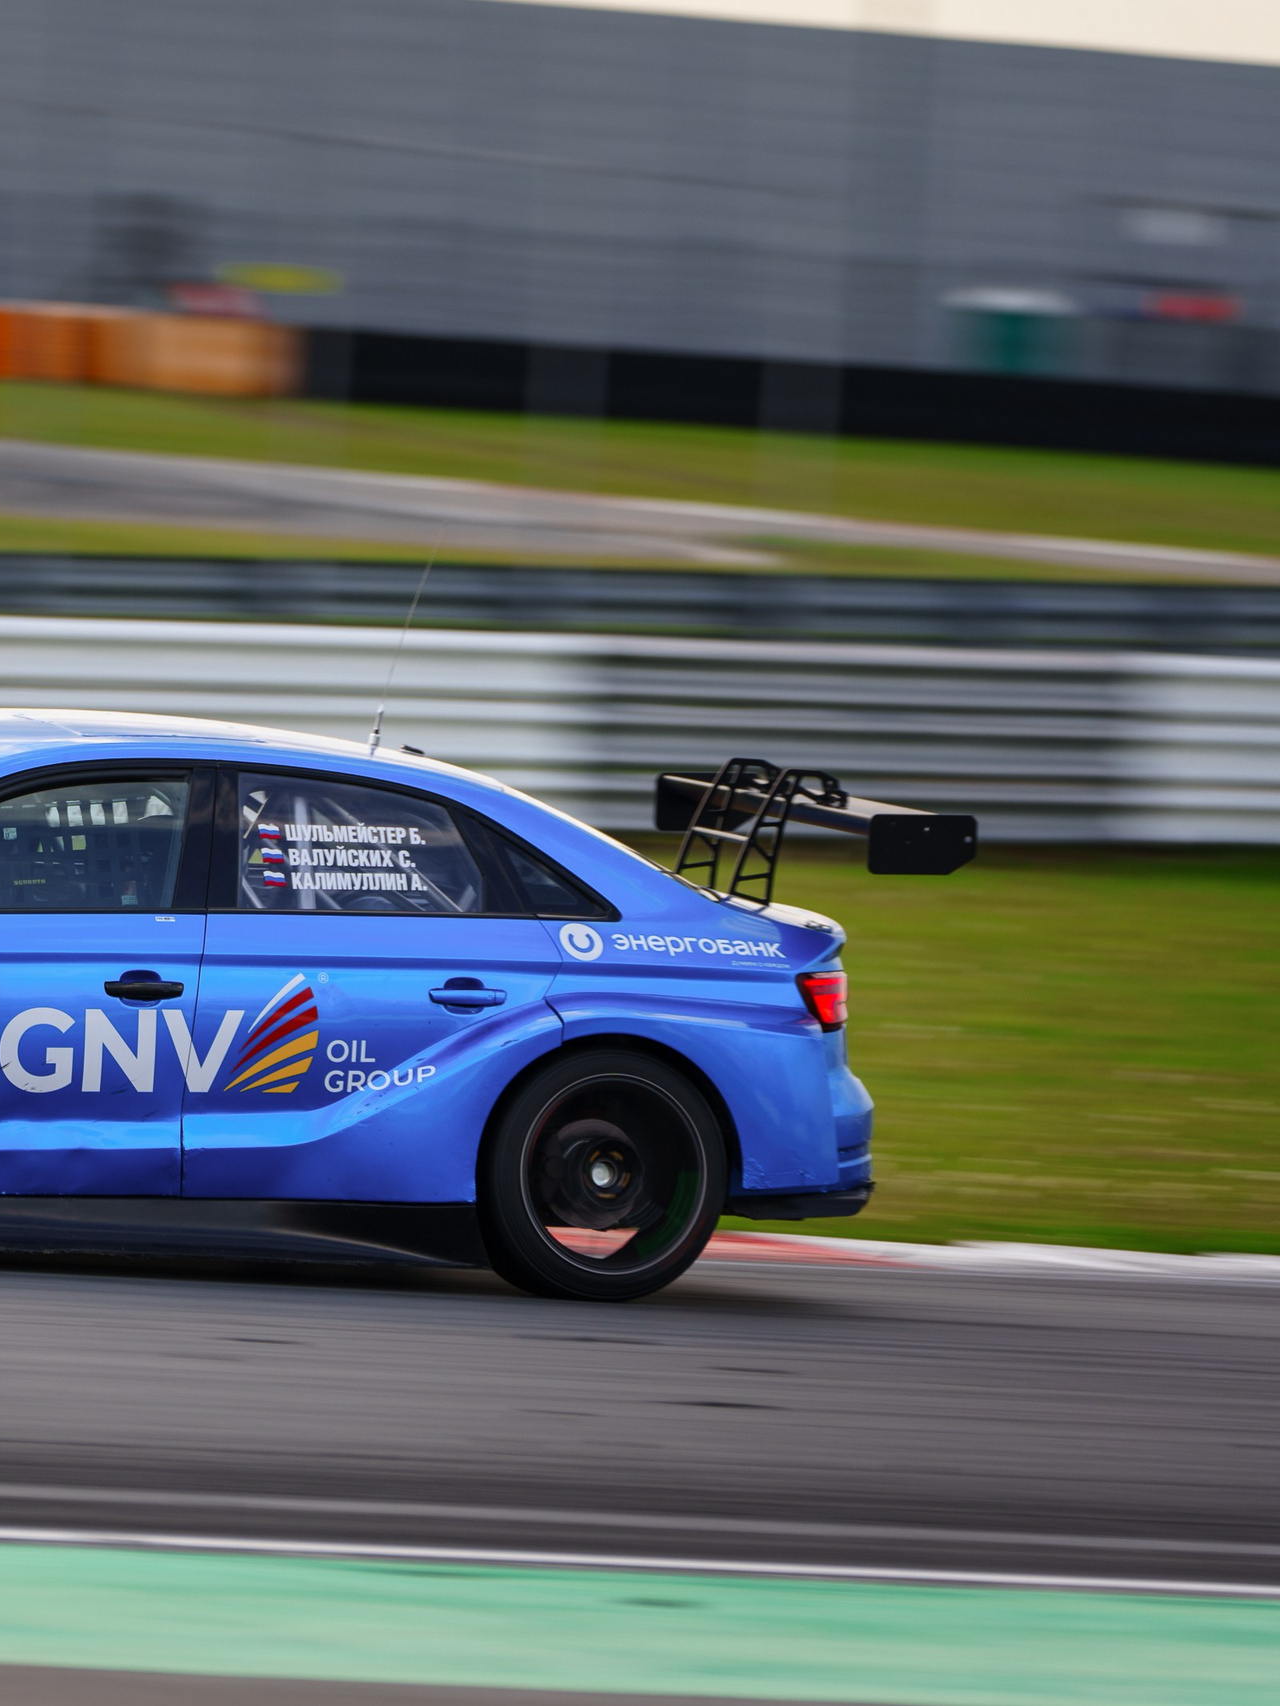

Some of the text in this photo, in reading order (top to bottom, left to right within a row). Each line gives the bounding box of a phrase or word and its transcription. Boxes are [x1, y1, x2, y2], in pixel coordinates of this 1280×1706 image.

[285, 823, 426, 845] ШУЛЬМЕЙСТЕР Б.
[289, 846, 416, 867] ВАЛУЙСКИХ С.
[291, 872, 428, 891] КАЛИМУЛЛИН А.
[611, 933, 787, 958] энергобанк
[326, 1040, 376, 1063] OIL
[324, 1065, 436, 1093] GROUP
